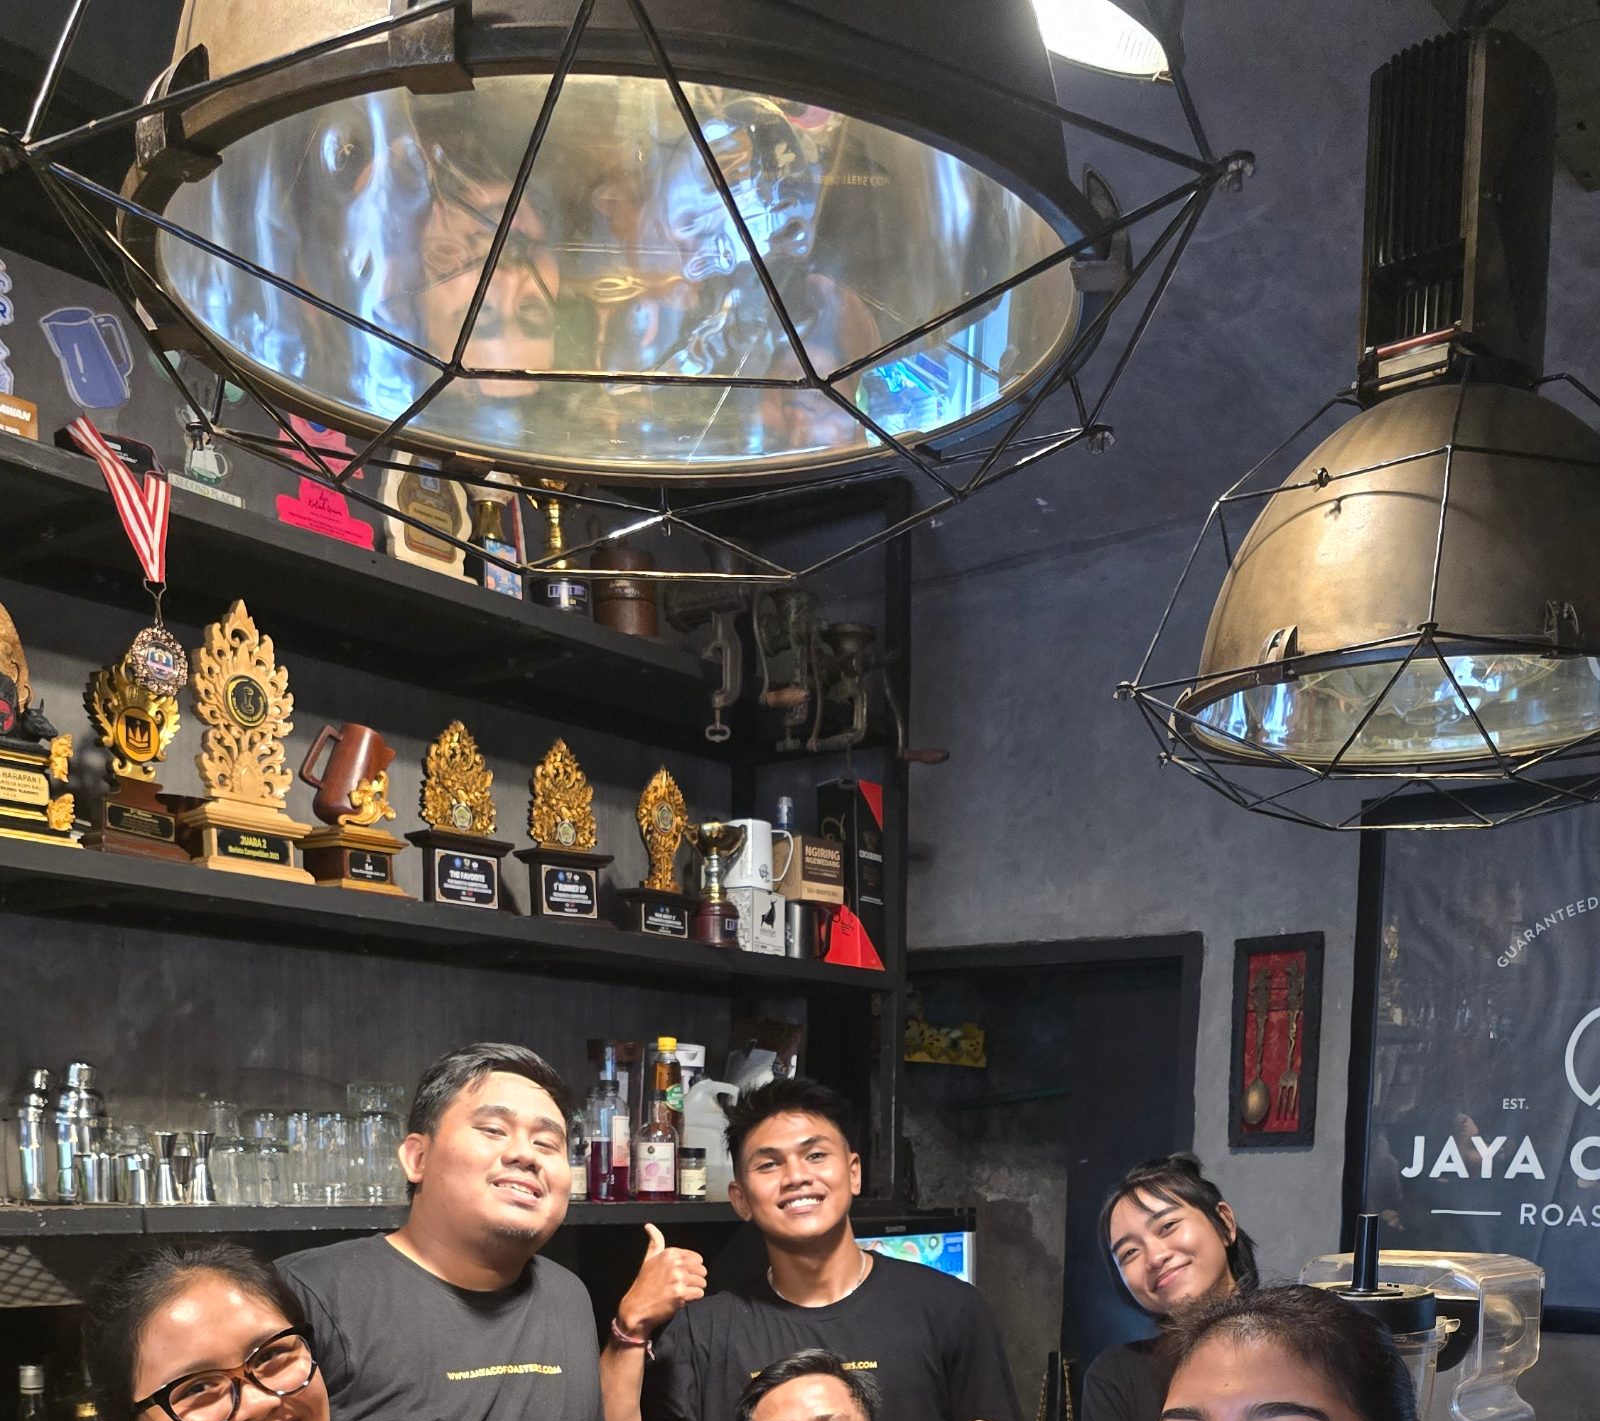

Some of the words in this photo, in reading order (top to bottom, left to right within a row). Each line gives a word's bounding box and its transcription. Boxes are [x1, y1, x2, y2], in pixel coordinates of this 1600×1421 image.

[3, 771, 37, 783] HARAPAN
[804, 845, 842, 862] NGIRING
[1496, 896, 1599, 968] GUARANTEED
[1502, 1097, 1530, 1110] EST.
[1400, 1135, 1546, 1180] JAYA
